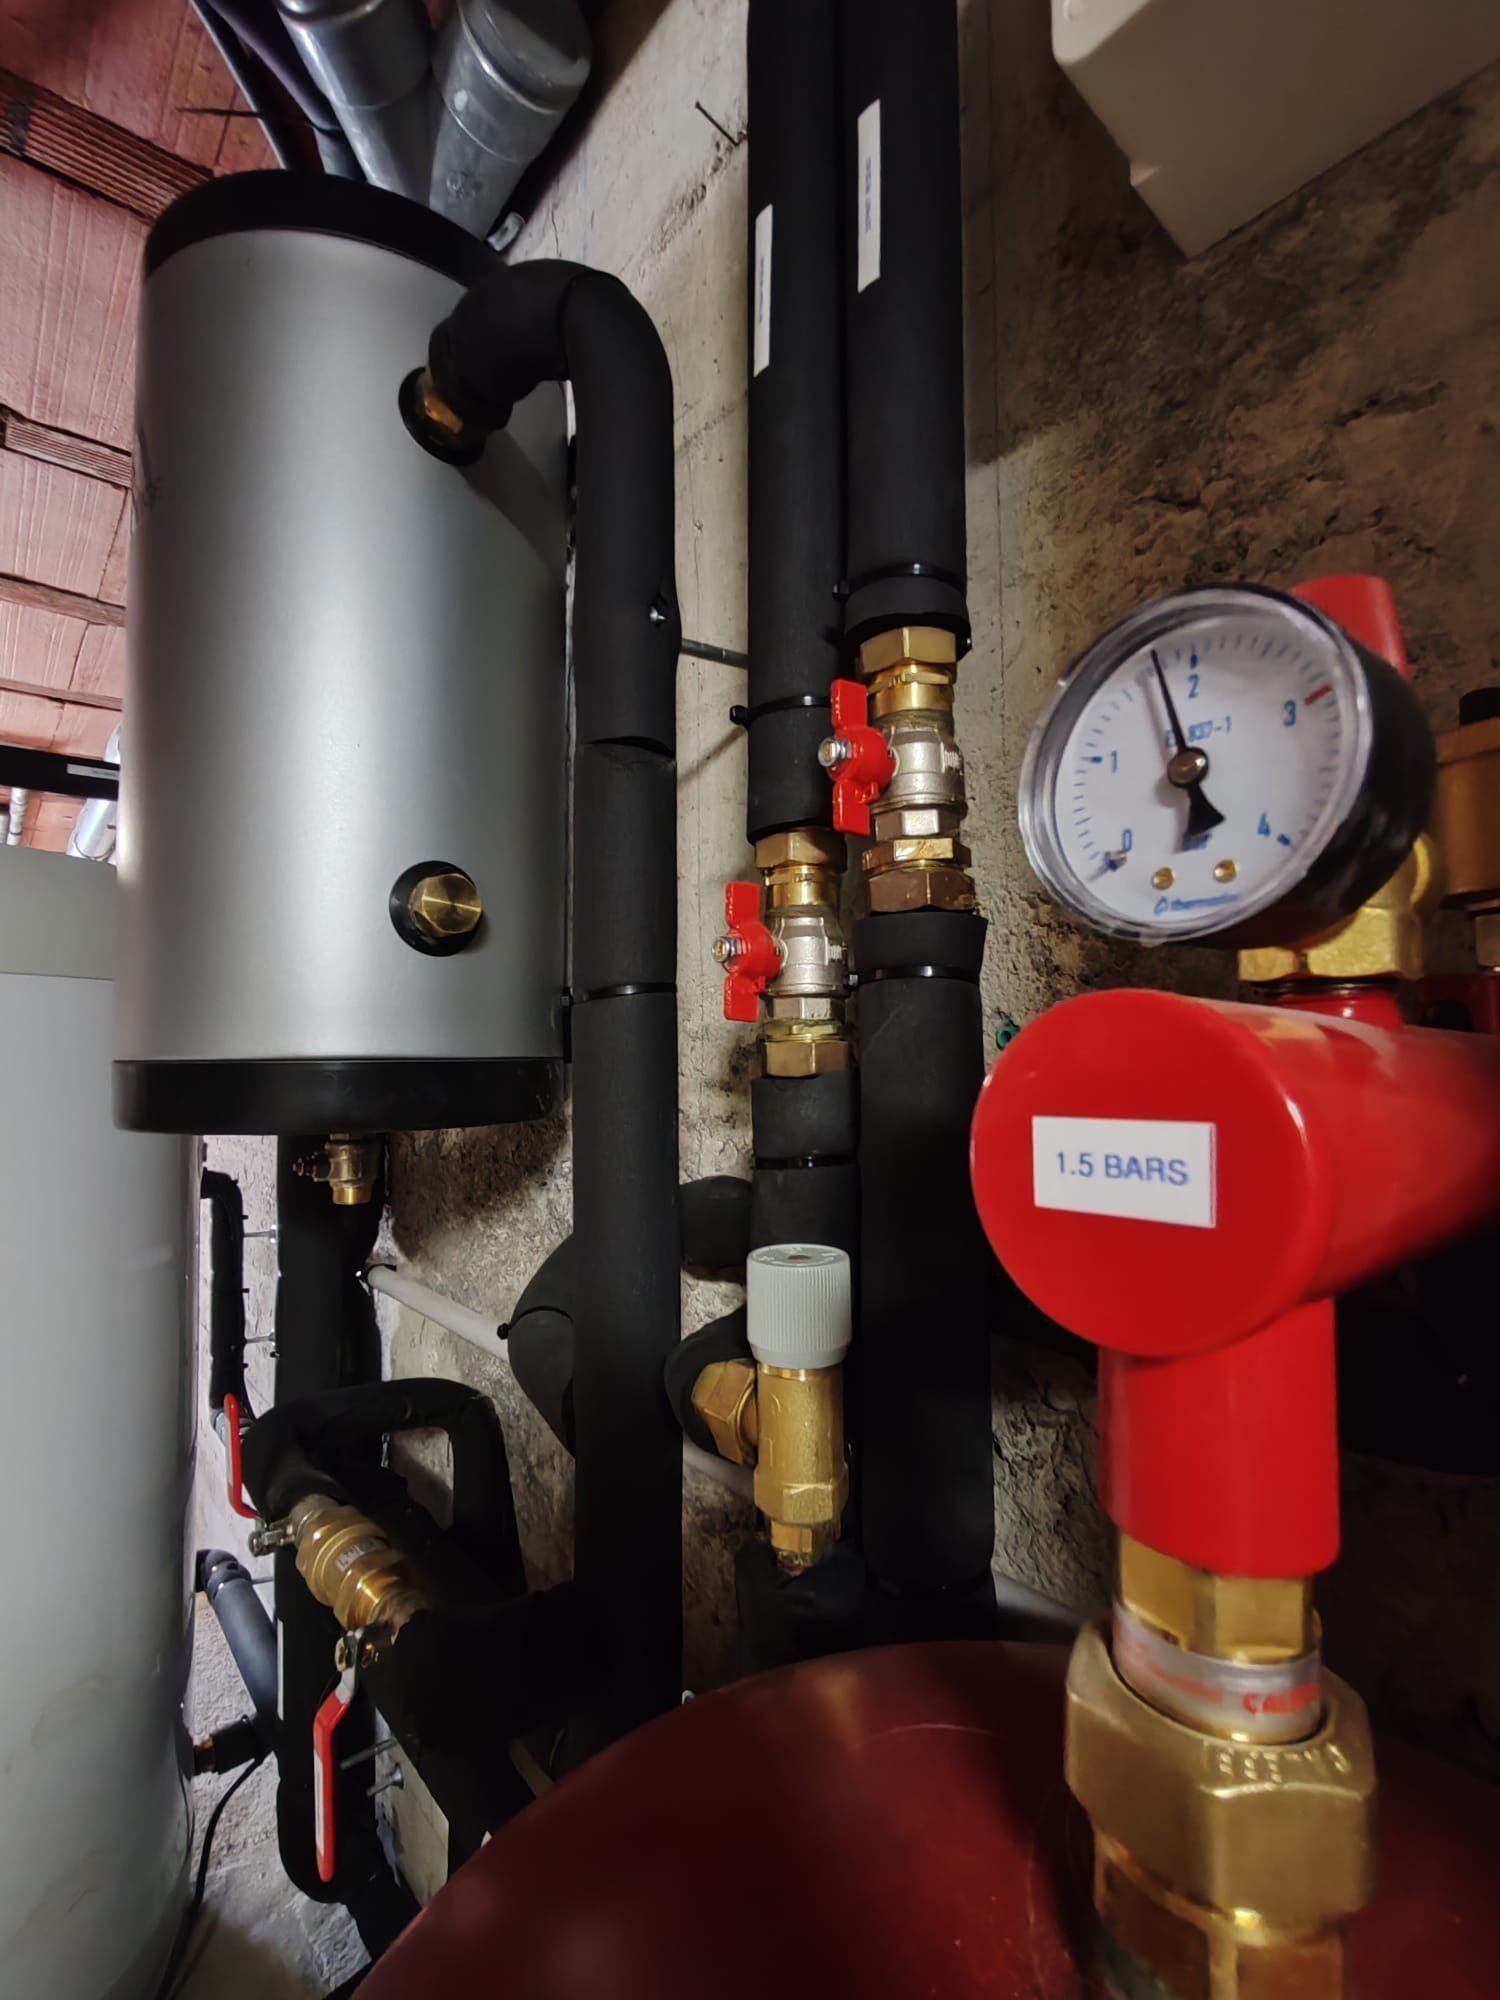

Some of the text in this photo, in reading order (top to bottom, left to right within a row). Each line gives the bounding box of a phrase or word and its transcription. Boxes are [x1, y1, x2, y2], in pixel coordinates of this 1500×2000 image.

[1188, 675, 1199, 698] 2
[1283, 701, 1297, 726] 3
[1110, 751, 1118, 773] 1
[1257, 812, 1271, 836] 4
[1121, 829, 1133, 852] 0
[1056, 1151, 1189, 1186] 1.5 BARS
